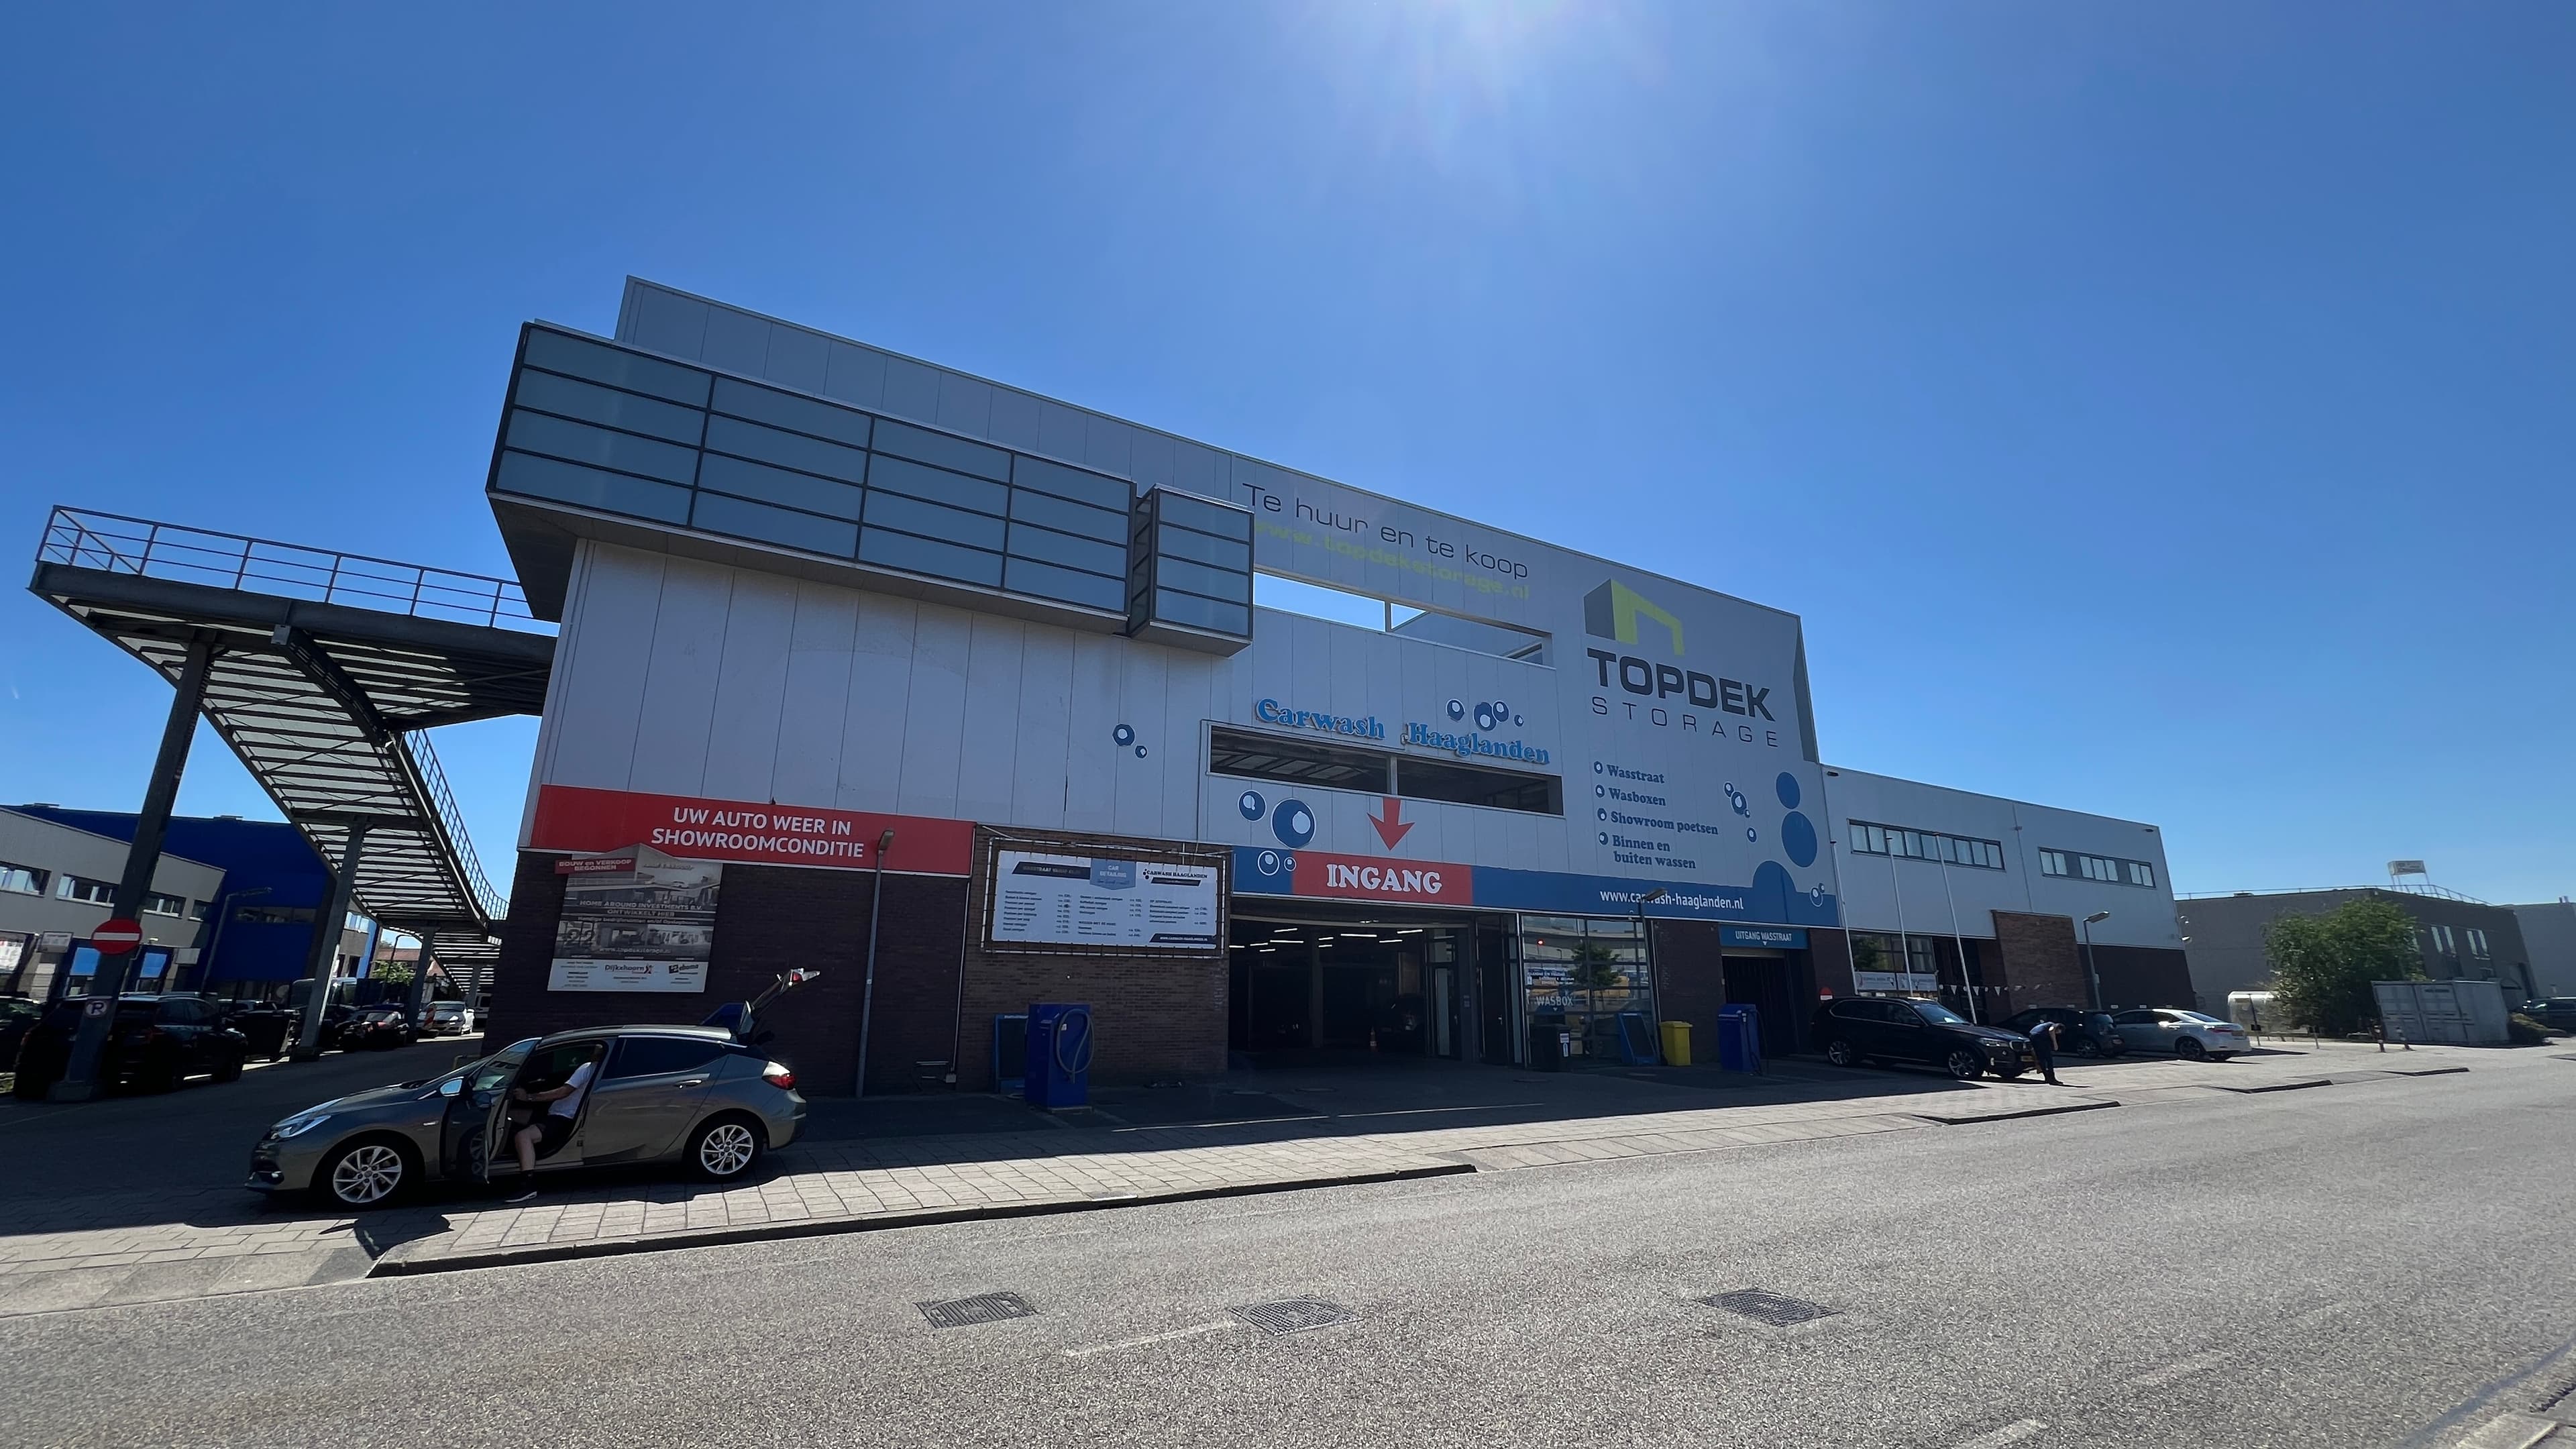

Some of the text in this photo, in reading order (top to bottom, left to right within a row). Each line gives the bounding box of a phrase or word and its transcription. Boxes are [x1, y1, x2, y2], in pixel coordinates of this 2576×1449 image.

[1242, 482, 1528, 580] Te huur en te koop
[1587, 647, 1776, 722] TOPDEK
[1256, 698, 1550, 765] Carwash Haaglanden
[1592, 696, 1778, 747] STORAGE
[1607, 764, 1665, 784] Wasstraat
[1609, 788, 1666, 806] Wasboxen
[674, 806, 851, 836] UW AUTO WEER IN
[1611, 810, 1719, 835] Showroom poetsen
[651, 828, 864, 858] SHOWROOMCONDITIE
[1612, 835, 1670, 851] Binnen en
[1613, 851, 1696, 869] buiten wassen
[1326, 863, 1442, 894] INGANG
[638, 902, 689, 910] INVESTMENTS
[1600, 890, 1744, 910] www.carash-haaglanden.nl
[1735, 930, 1792, 942] UITGANG WASSTRAAT
[1536, 996, 1574, 1006] WASBOX
